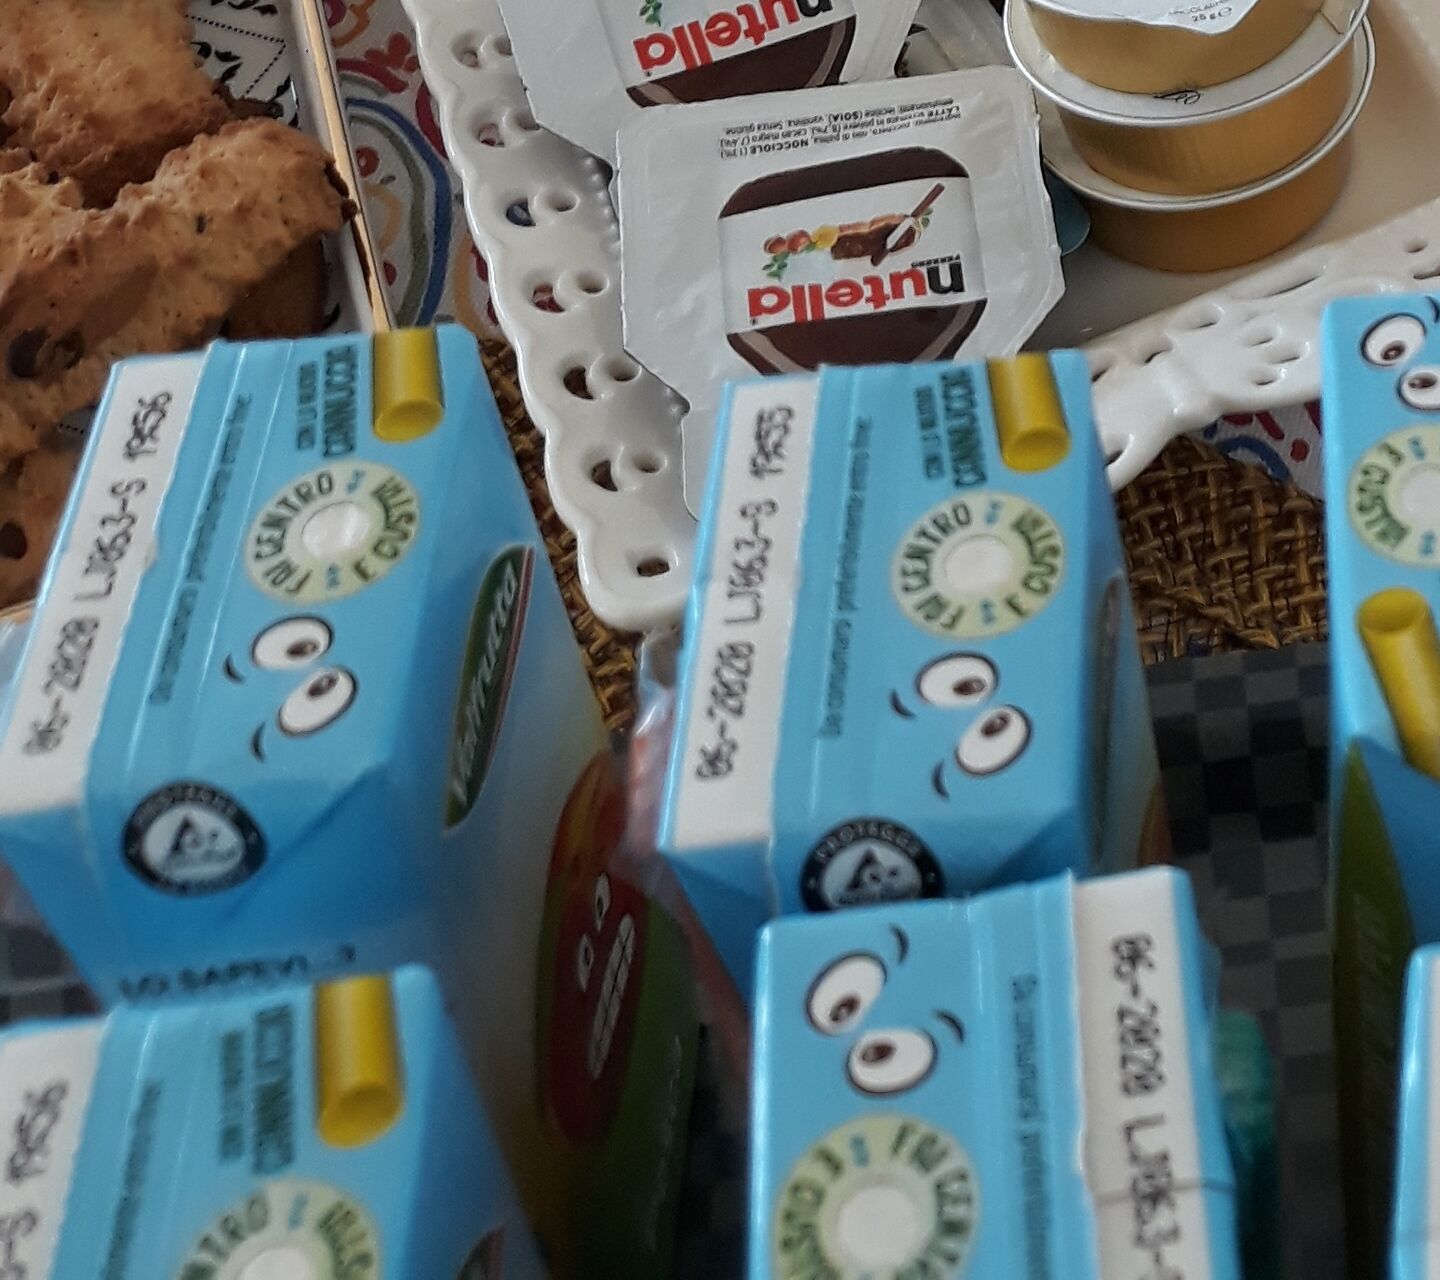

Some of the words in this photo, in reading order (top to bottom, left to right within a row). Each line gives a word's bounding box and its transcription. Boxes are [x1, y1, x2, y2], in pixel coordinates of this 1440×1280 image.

[750, 139, 809, 155] NOCCIOLE
[745, 254, 966, 325] nutella
[900, 502, 973, 596] CENTRO
